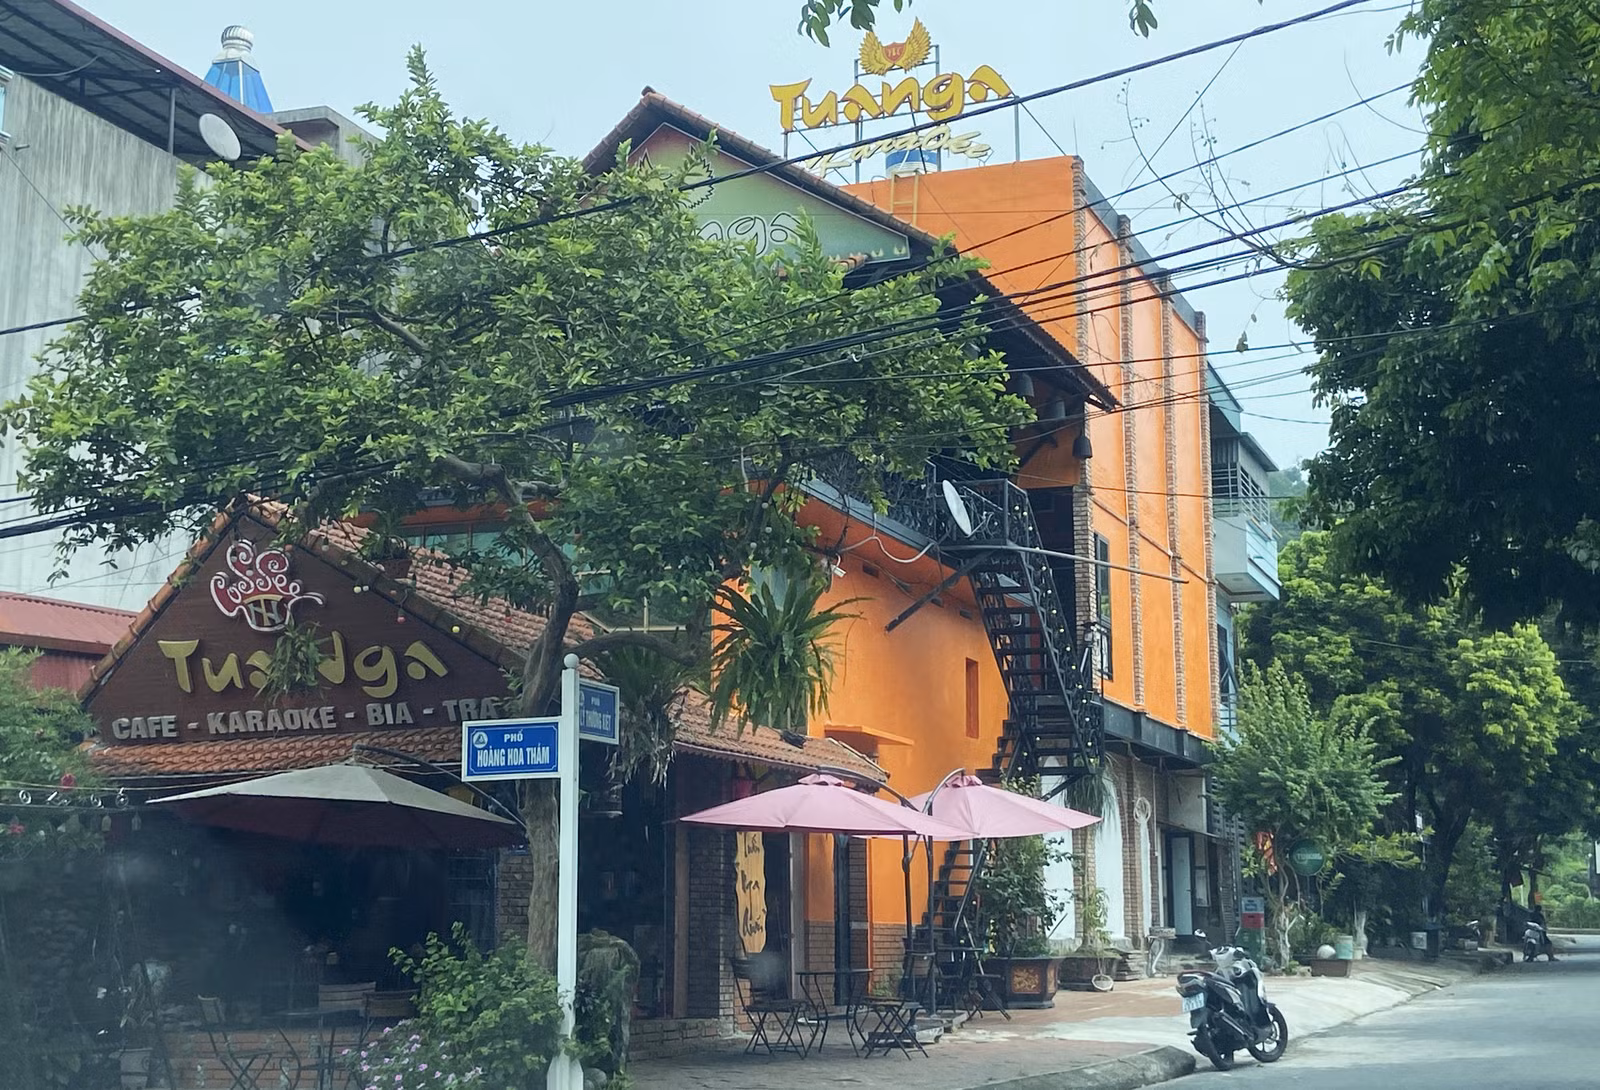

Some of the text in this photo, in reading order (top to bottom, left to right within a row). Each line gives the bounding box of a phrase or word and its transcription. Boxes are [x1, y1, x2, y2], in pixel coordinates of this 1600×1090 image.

[112, 714, 178, 740] CAFE
[207, 705, 338, 735] KARAOKE
[367, 702, 415, 727] BIA
[503, 729, 524, 743] PHỐ
[477, 742, 550, 768] HOÀNG HOA THÁM
